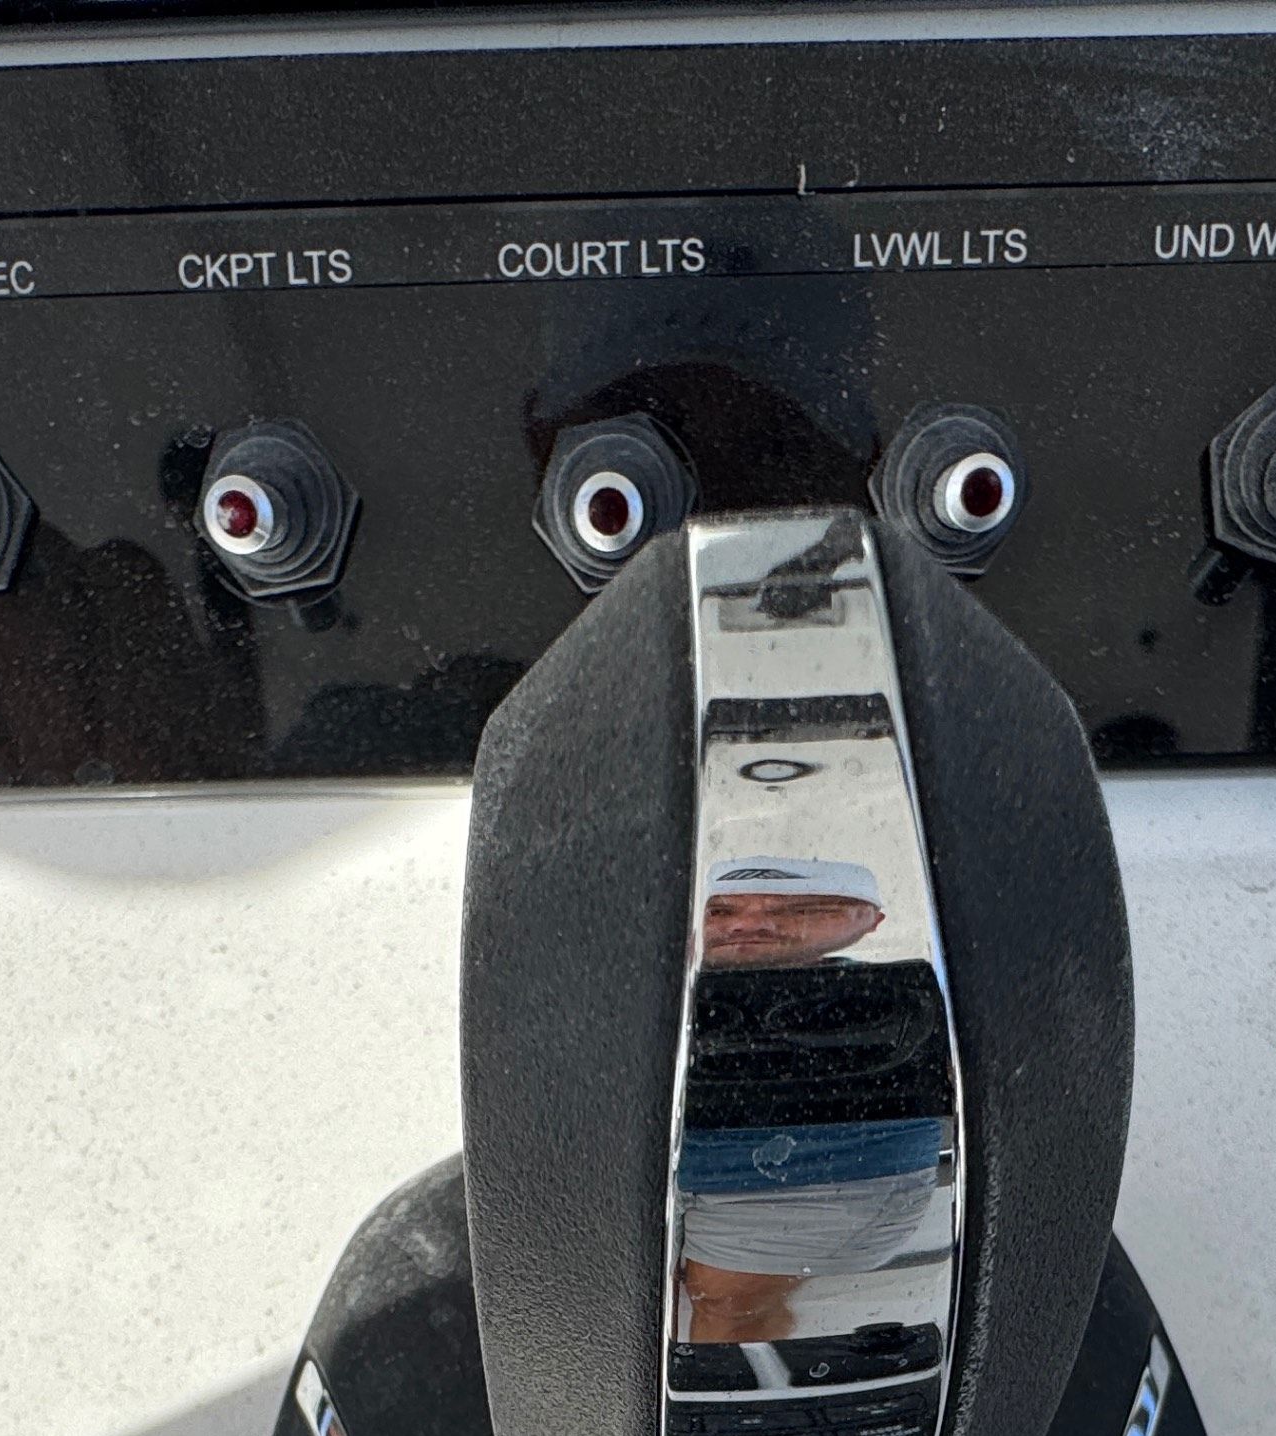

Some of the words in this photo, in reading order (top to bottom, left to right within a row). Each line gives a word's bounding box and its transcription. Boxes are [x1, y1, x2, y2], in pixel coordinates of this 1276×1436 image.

[498, 240, 630, 278] COURT
[640, 237, 705, 274] LTS
[854, 231, 952, 268] LVWL
[962, 228, 1028, 265] LTS
[1155, 223, 1235, 259] UND
[178, 252, 276, 289] CKPT
[287, 249, 352, 285] LTS
